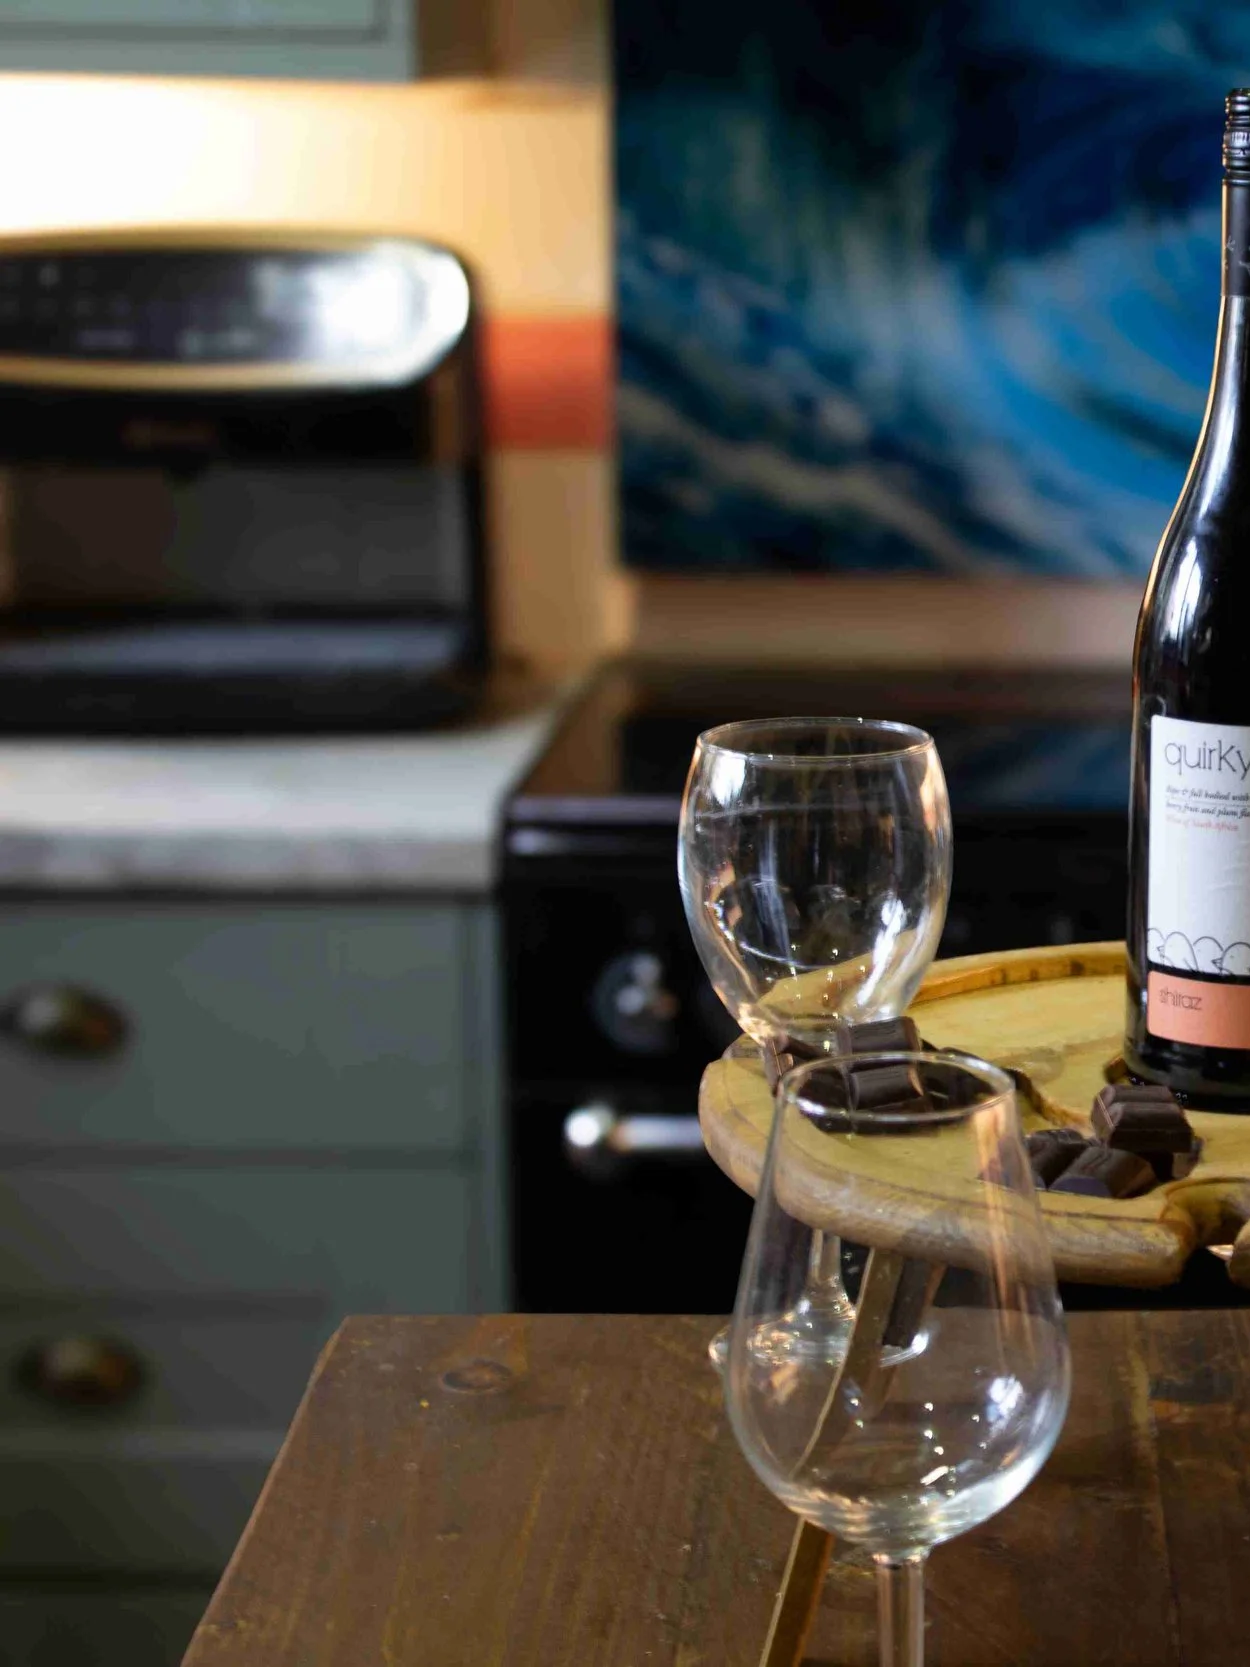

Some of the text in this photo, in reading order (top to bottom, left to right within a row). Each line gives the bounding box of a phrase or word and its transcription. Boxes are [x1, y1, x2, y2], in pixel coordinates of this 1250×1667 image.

[1232, 793, 1249, 801] with
[1201, 806, 1216, 815] and
[1216, 807, 1238, 817] plum
[1159, 986, 1203, 1011] shiraz
